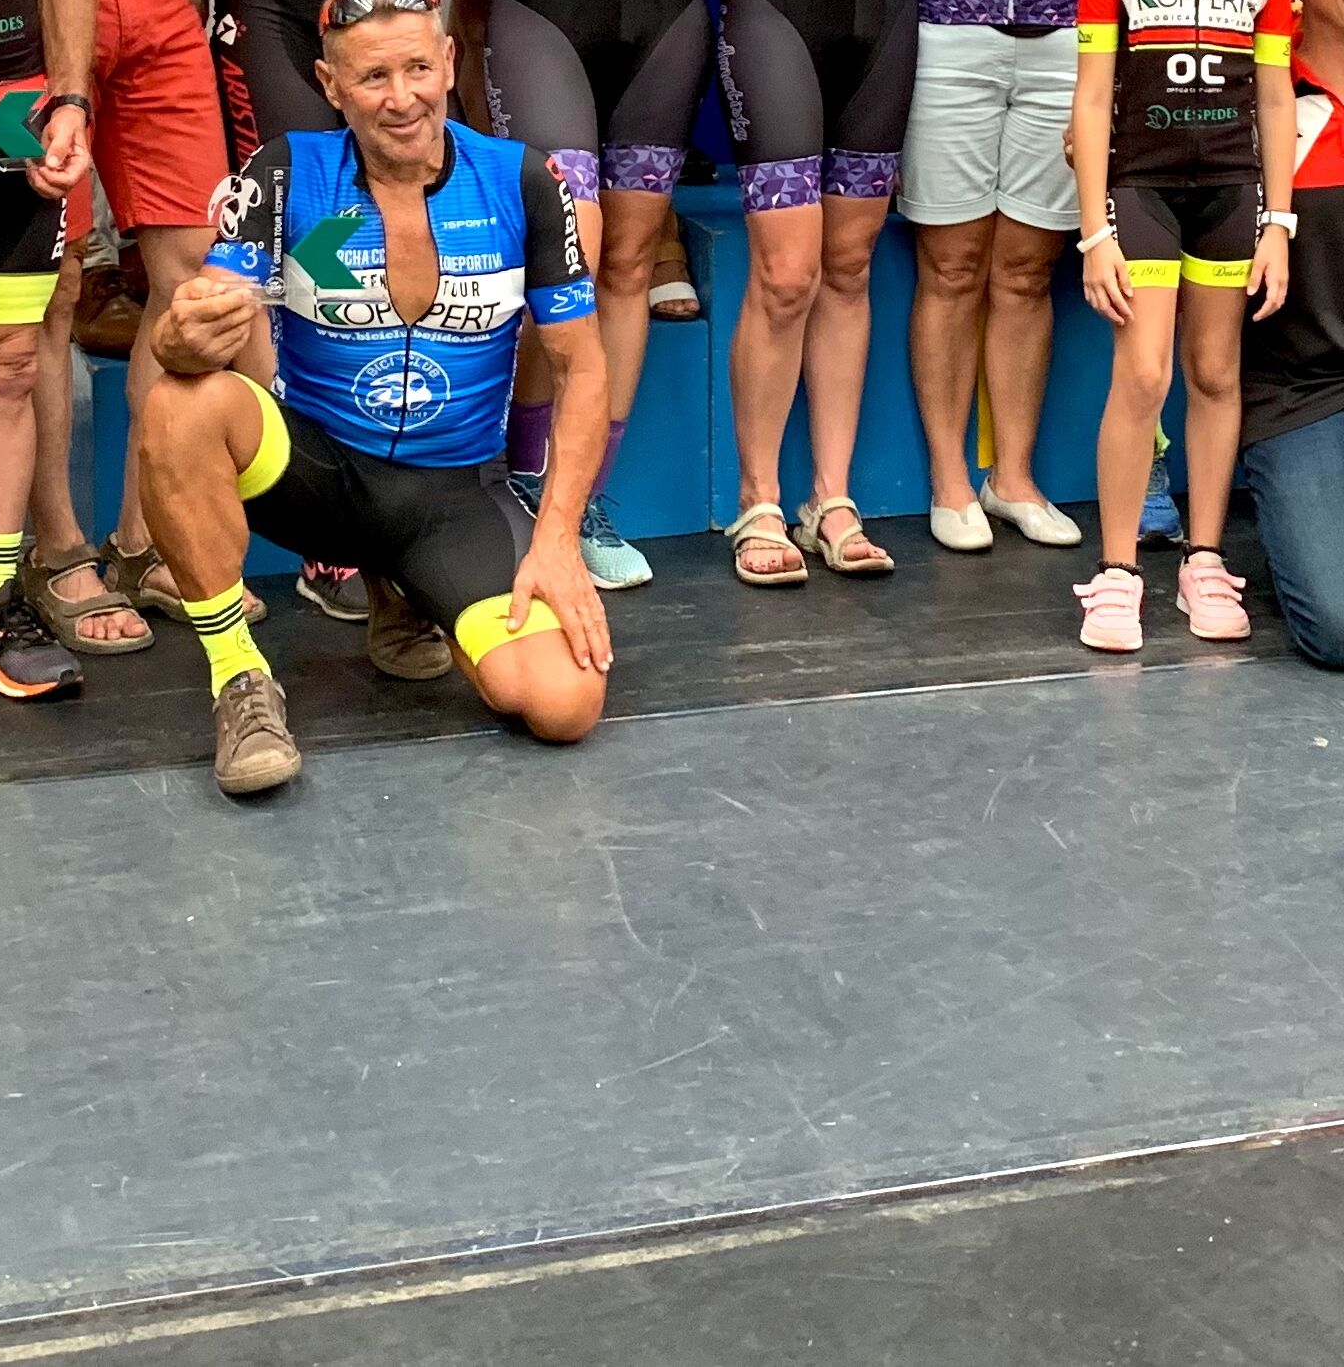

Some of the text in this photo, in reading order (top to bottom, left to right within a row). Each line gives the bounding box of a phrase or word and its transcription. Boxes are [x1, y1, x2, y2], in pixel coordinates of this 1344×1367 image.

[1166, 53, 1226, 85] OC
[220, 54, 262, 166] ARISTID
[274, 215, 283, 236] TOUR
[273, 238, 283, 264] GREEN
[336, 250, 370, 266] RCHA
[443, 279, 481, 297] TOUR
[366, 354, 443, 379] BICI CLUB
